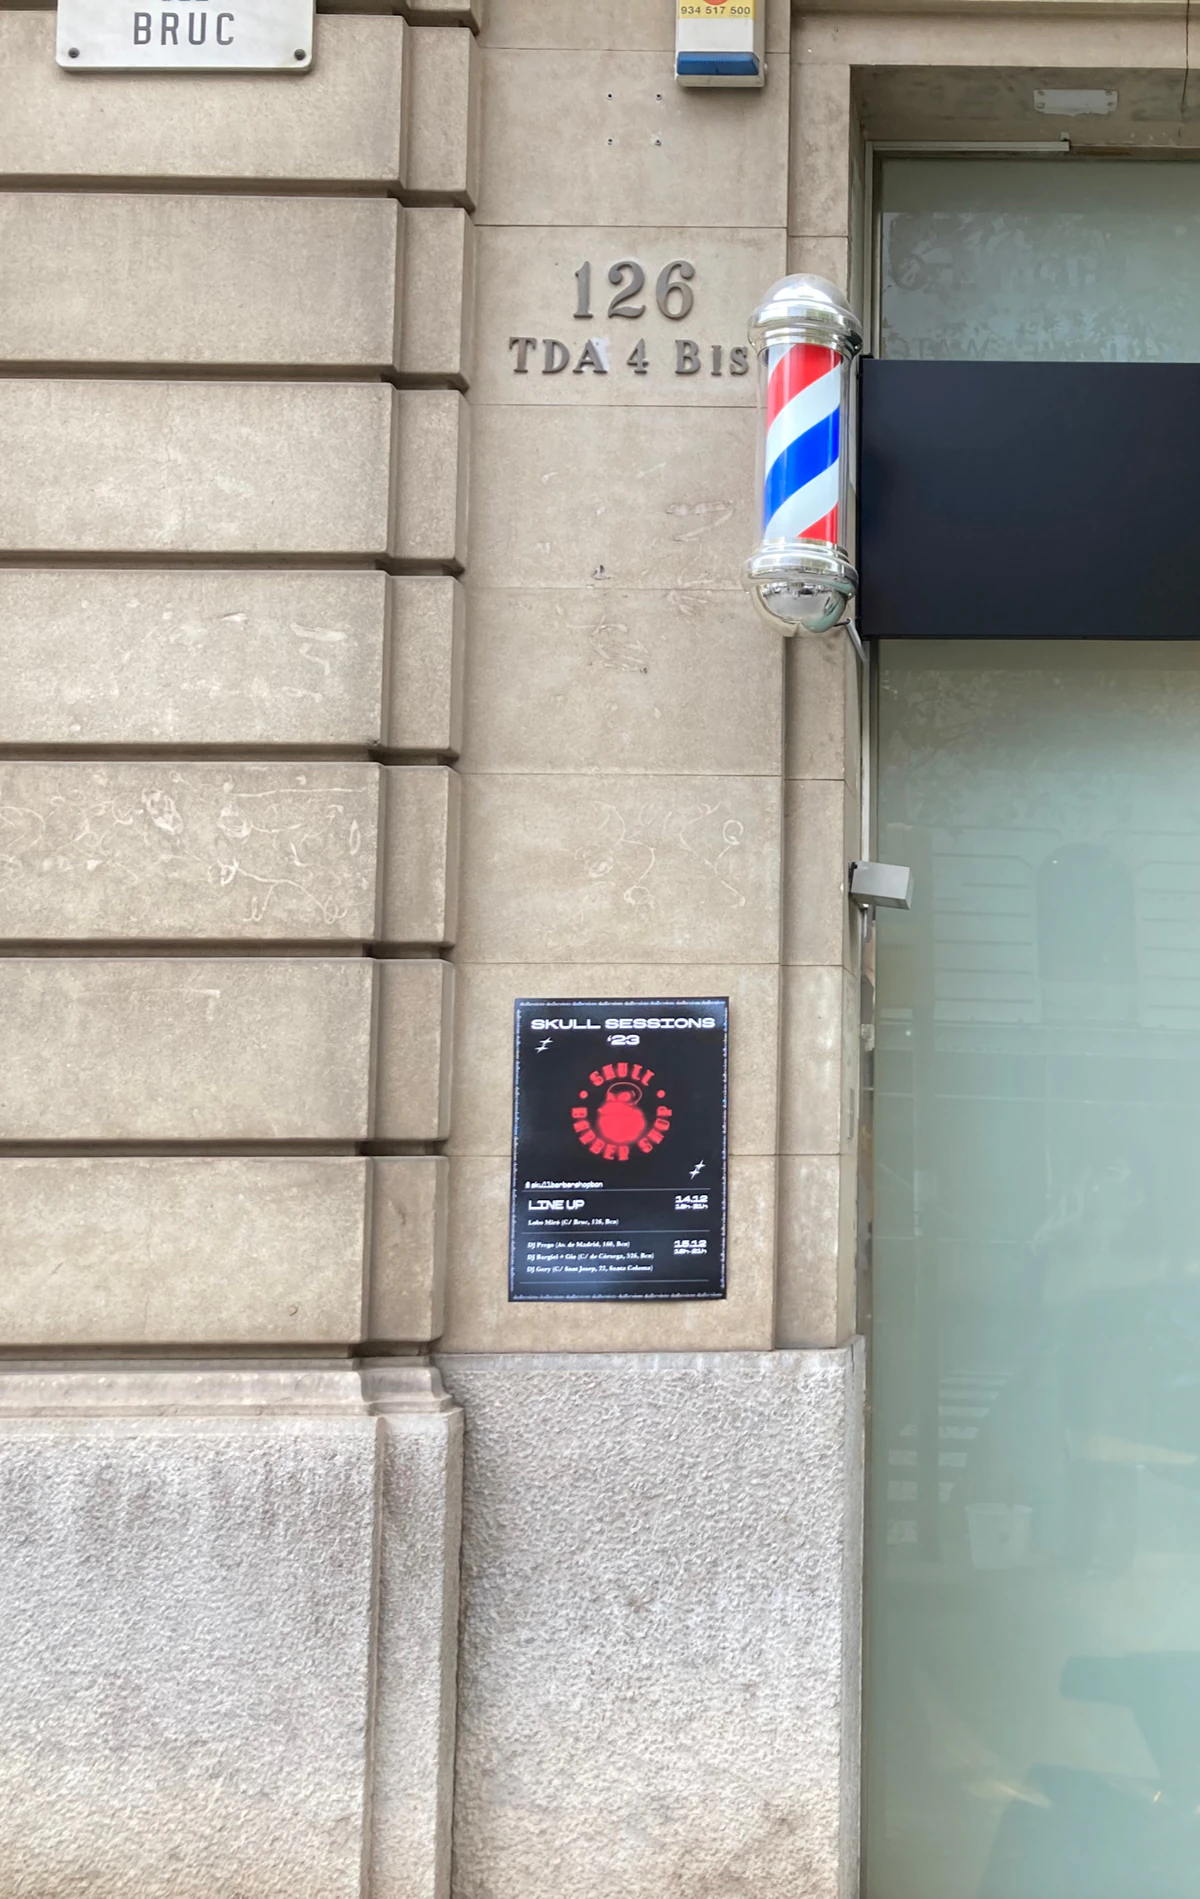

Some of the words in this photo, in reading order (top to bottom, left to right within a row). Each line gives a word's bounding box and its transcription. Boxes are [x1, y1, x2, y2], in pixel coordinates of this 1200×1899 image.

[680, 6, 701, 15] 934
[705, 6, 726, 15] 517
[730, 6, 751, 15] 500
[133, 12, 235, 45] BRUC
[573, 260, 695, 320] 126
[509, 337, 608, 373] TDA
[627, 338, 648, 374] 4
[530, 1018, 601, 1030] SKULL
[604, 1017, 716, 1030] SESSIONS
[589, 1062, 655, 1086] SKULL
[572, 1107, 629, 1161] BARBER
[638, 1105, 672, 1153] SHOP
[528, 1199, 565, 1211] LINE
[566, 1199, 585, 1211] UP
